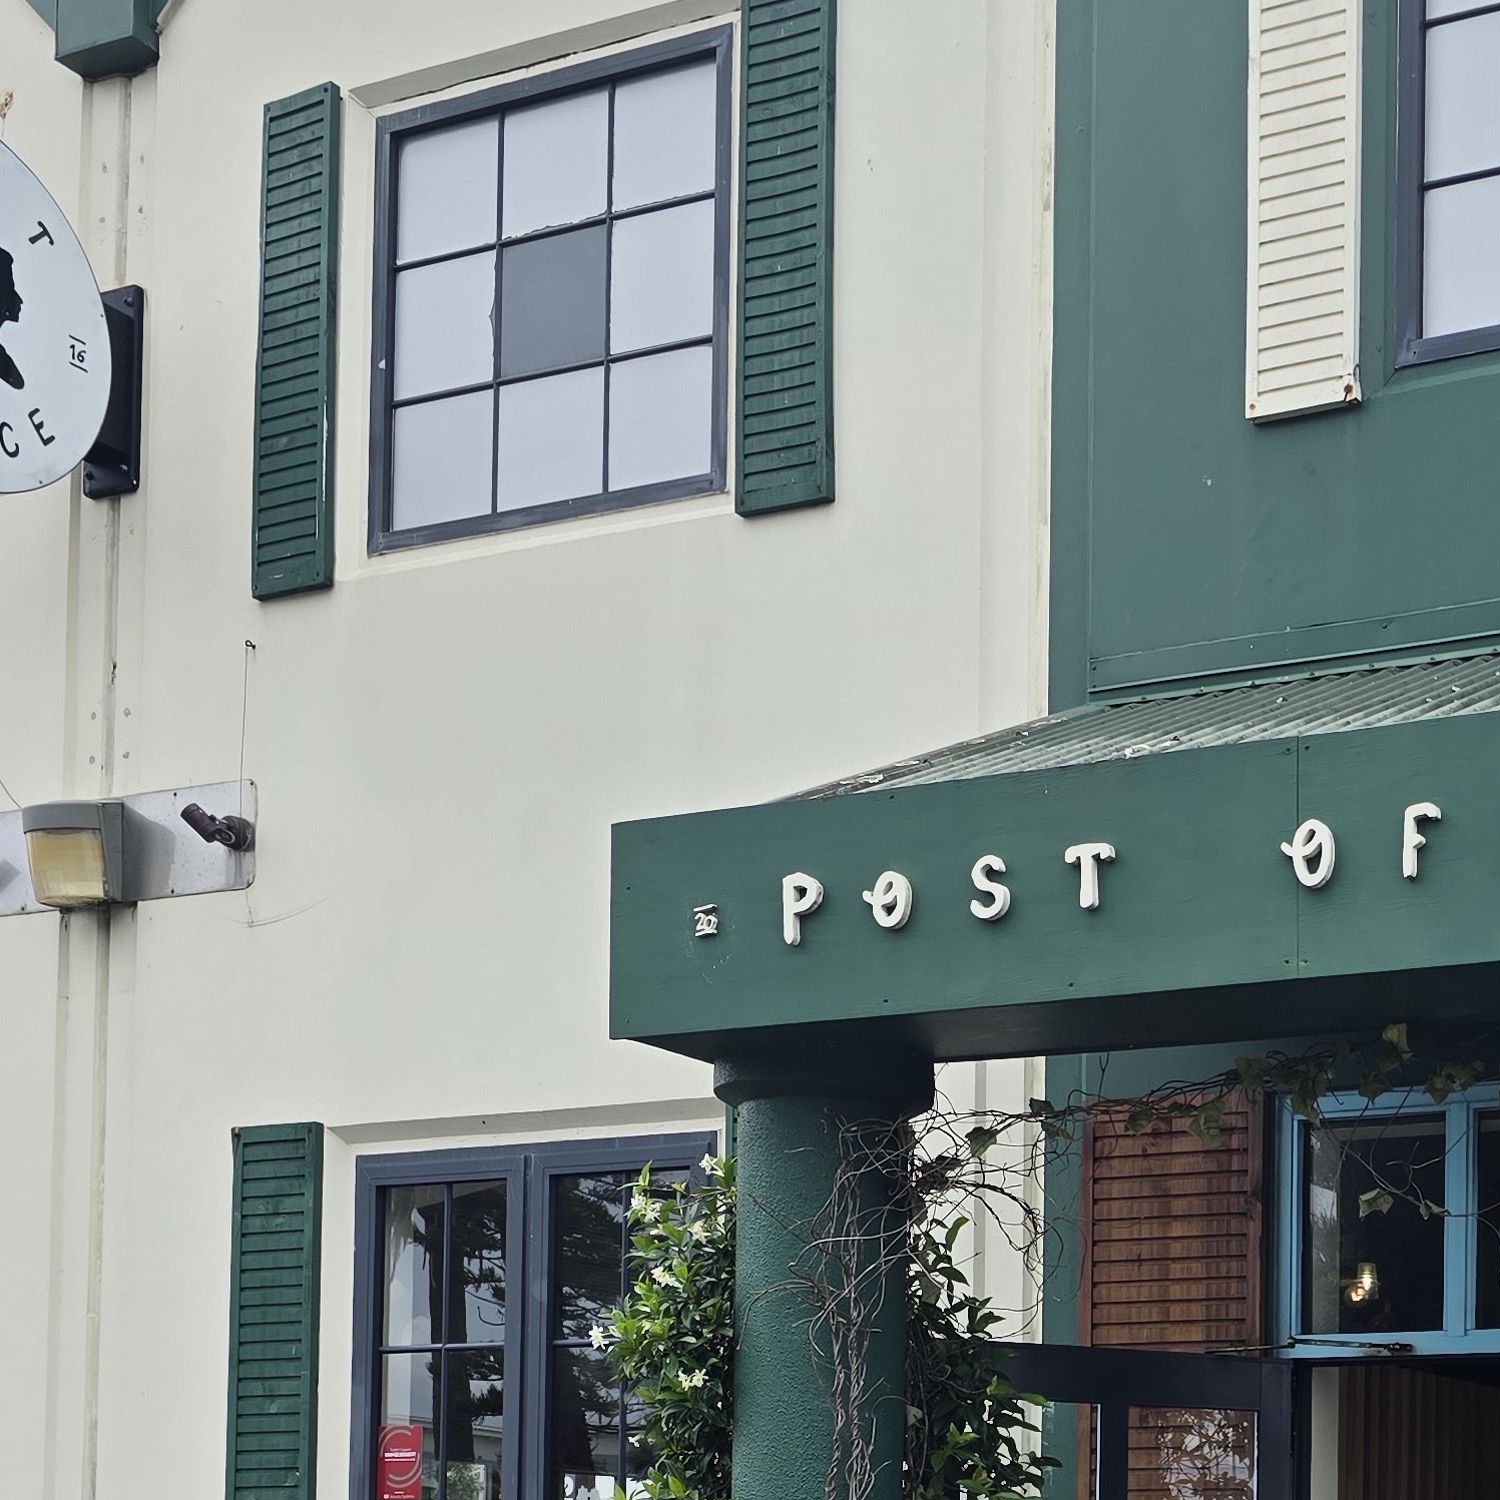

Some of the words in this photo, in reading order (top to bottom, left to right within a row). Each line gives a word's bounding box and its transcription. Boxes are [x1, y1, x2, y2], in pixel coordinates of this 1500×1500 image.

[69, 343, 87, 364] 16
[694, 912, 718, 932] 20
[781, 841, 1116, 946] POST
